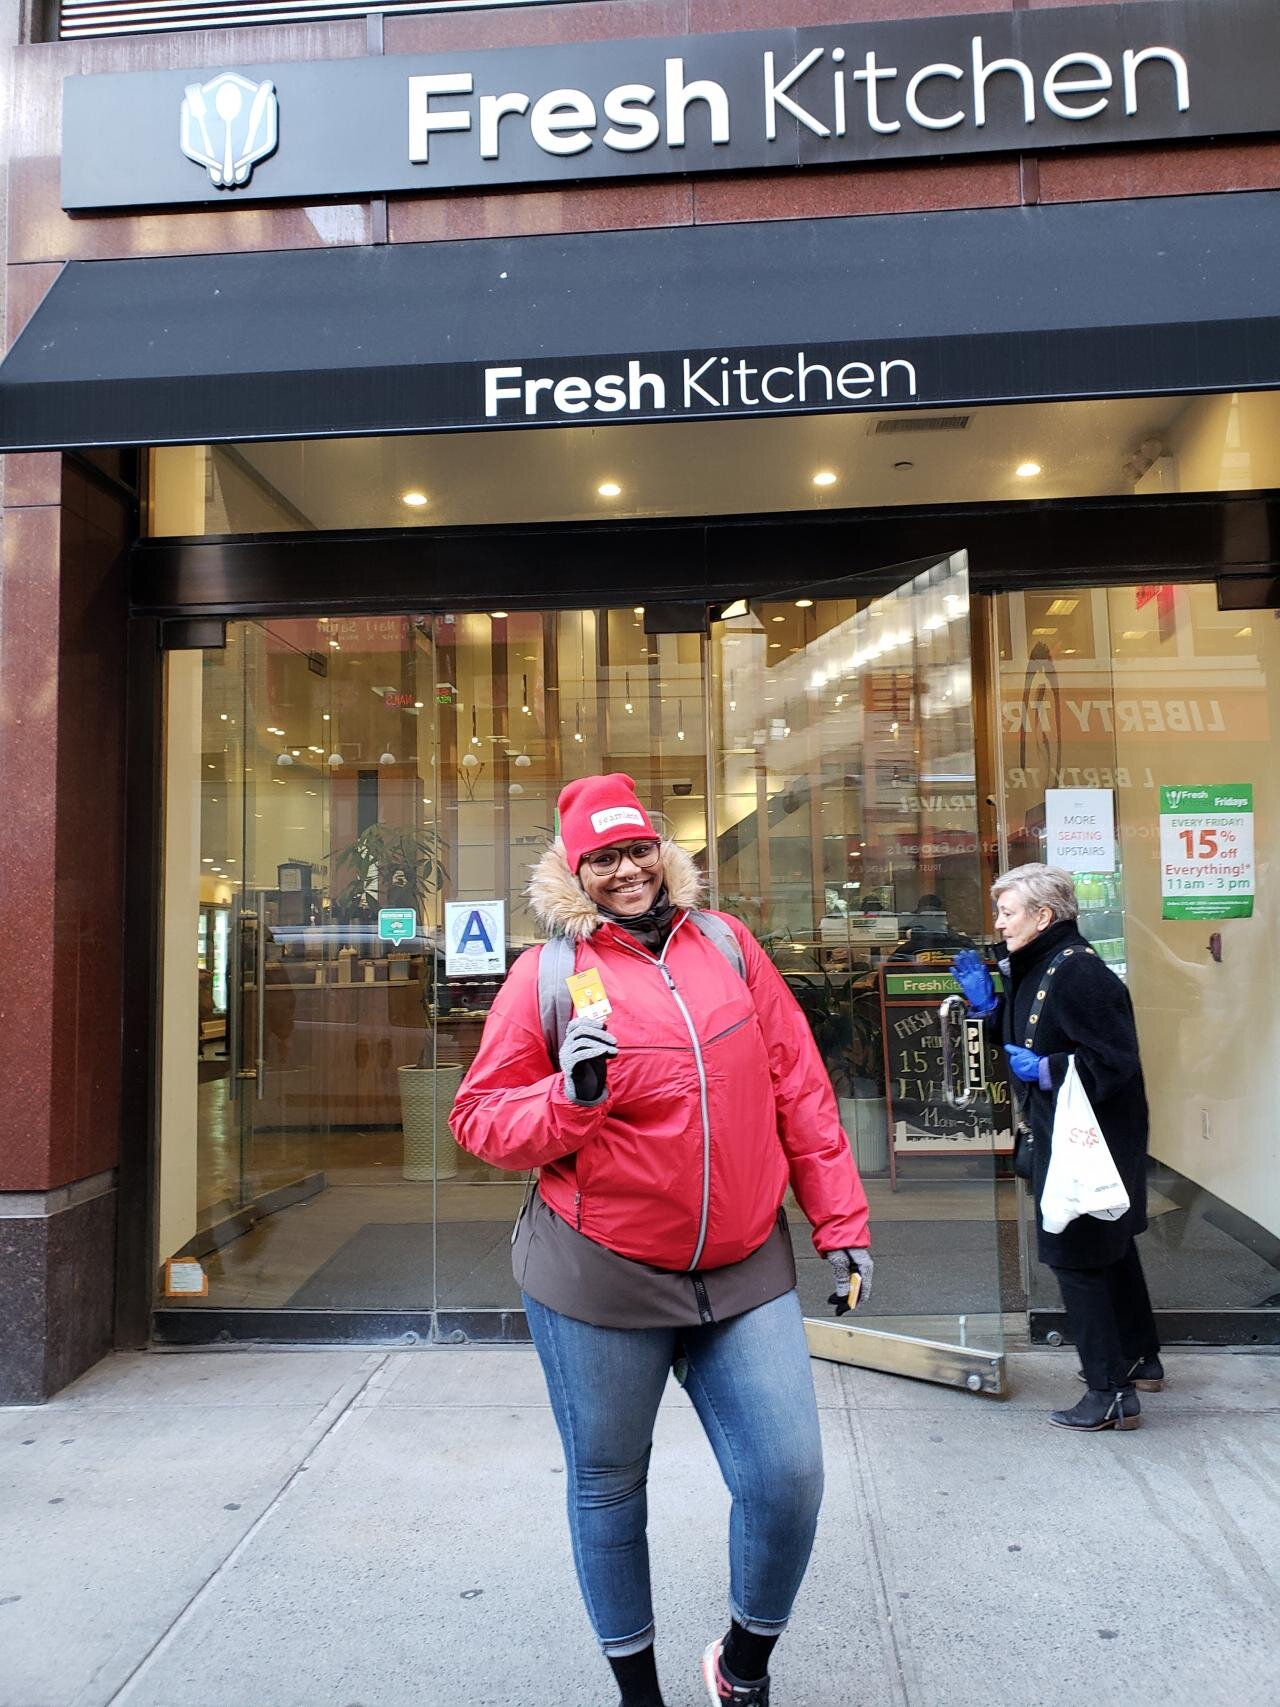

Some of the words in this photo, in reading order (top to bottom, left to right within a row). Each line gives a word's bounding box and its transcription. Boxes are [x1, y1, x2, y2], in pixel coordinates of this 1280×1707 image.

[408, 57, 732, 164] Fresh
[763, 35, 1191, 141] Kitchen
[484, 360, 666, 417] Fresh
[683, 352, 917, 408] Kitchen
[1182, 790, 1209, 799] Fresh
[1214, 797, 1249, 808] Fridays
[1063, 815, 1096, 825] MORE
[1171, 818, 1203, 827] EVERY
[1205, 817, 1245, 827] FRIDAY!
[1057, 831, 1103, 841] SEATING
[1056, 846, 1106, 856] UPSTAIRS
[1220, 848, 1238, 859] off
[1167, 878, 1205, 890] 11am
[456, 911, 494, 954] A
[967, 1027, 980, 1082] PULL
